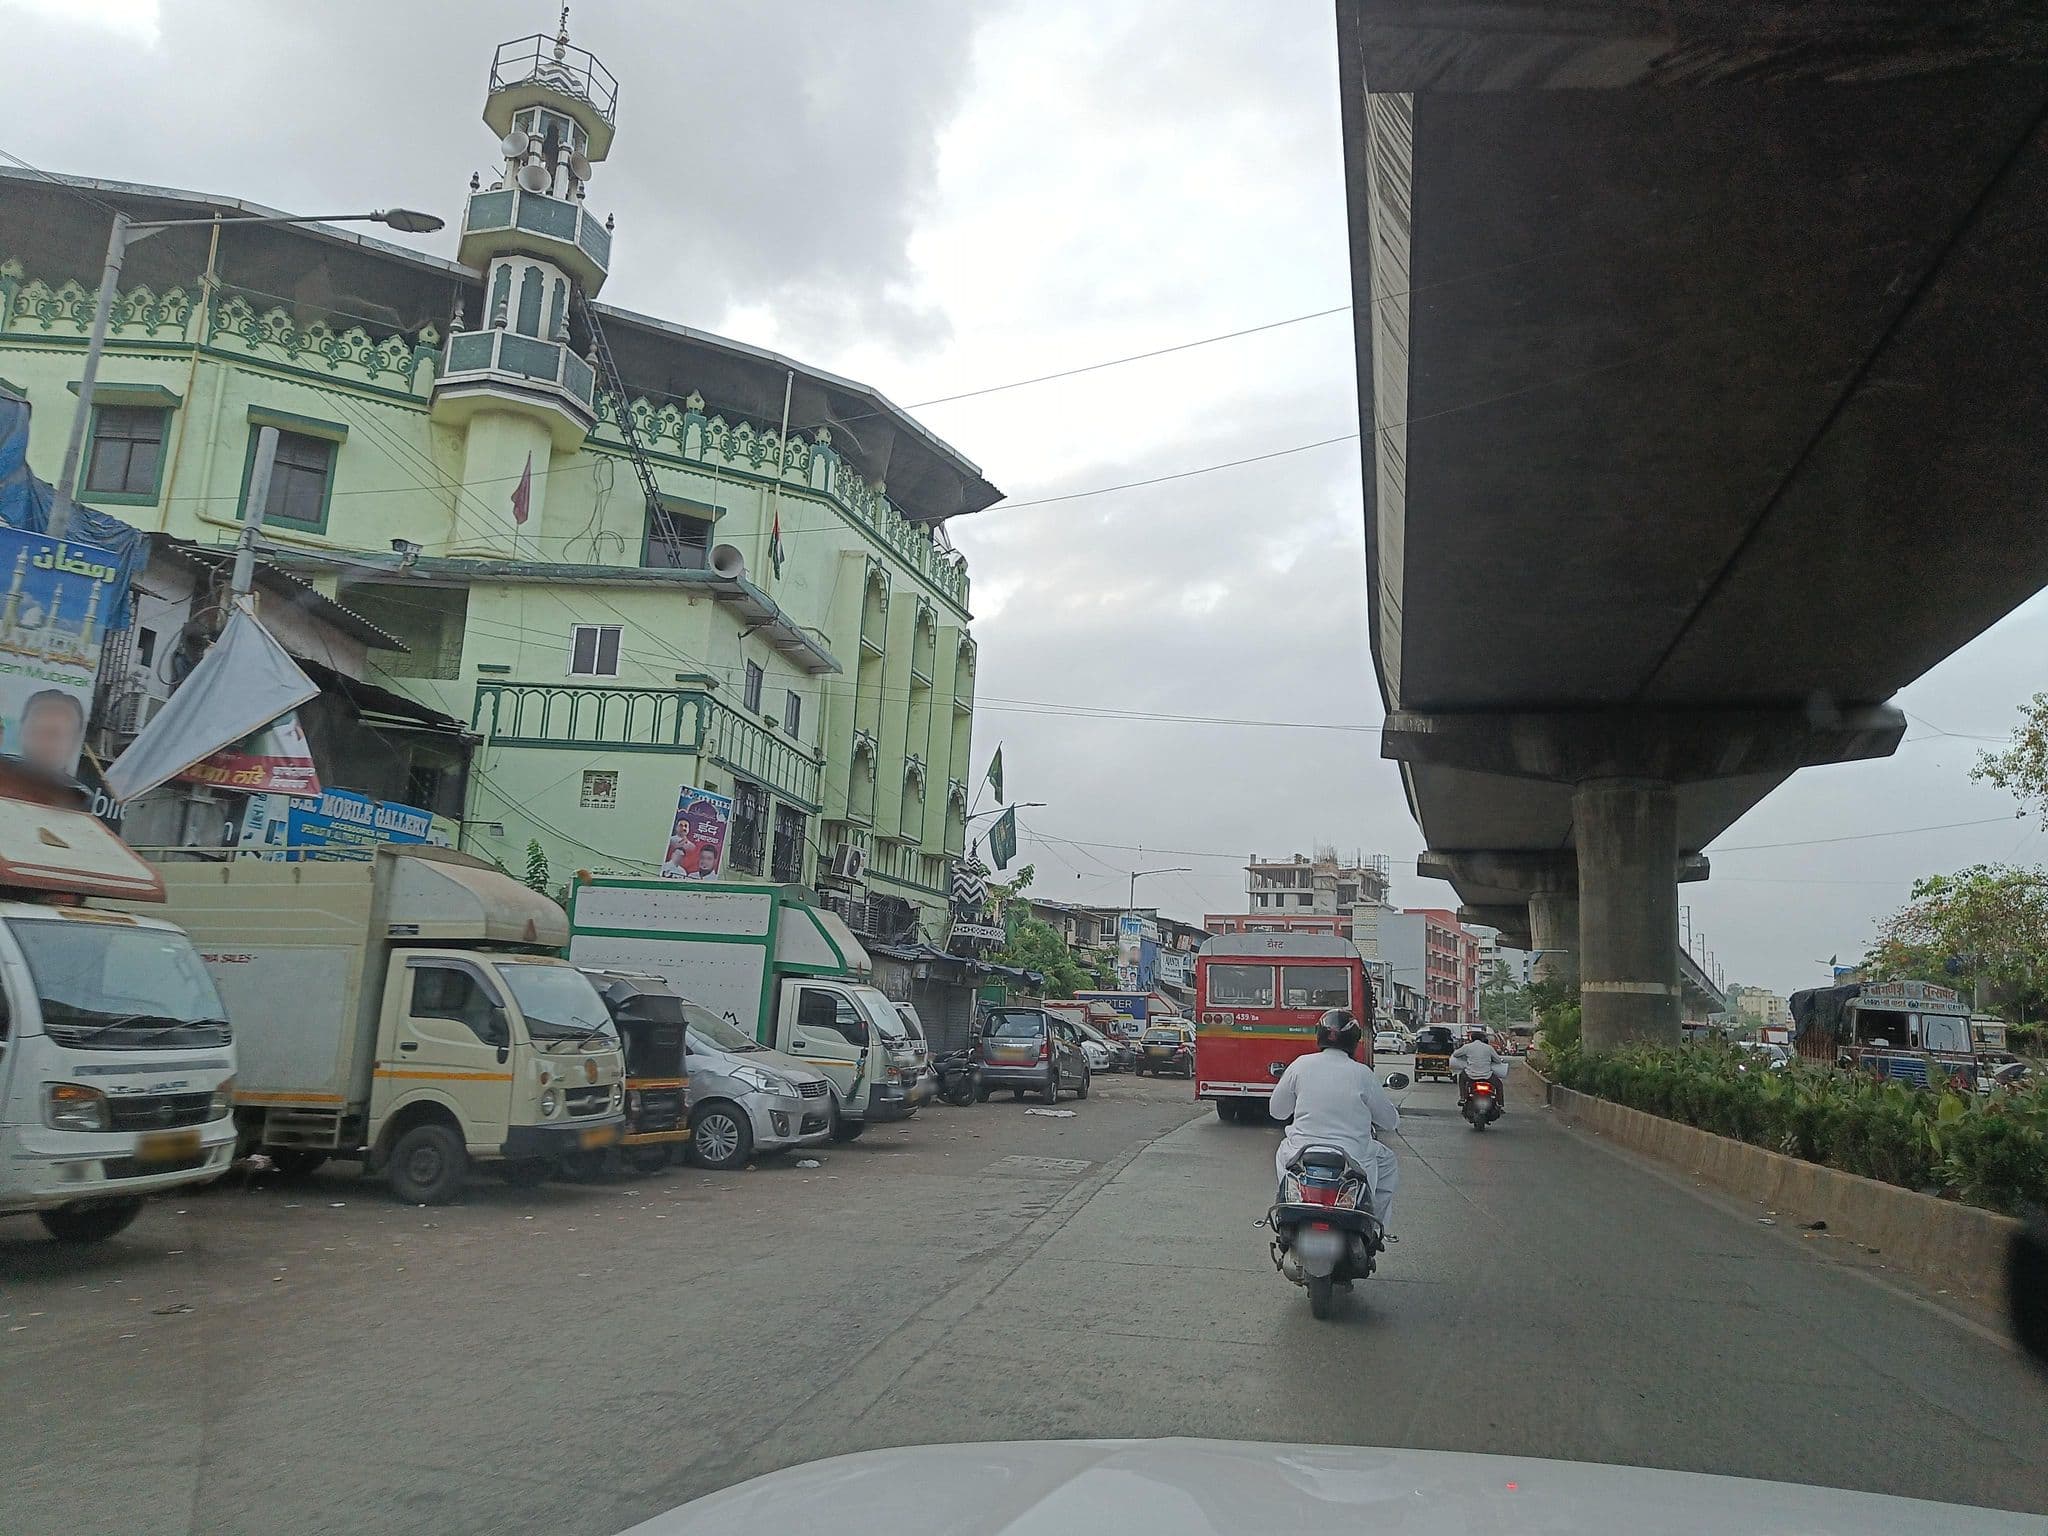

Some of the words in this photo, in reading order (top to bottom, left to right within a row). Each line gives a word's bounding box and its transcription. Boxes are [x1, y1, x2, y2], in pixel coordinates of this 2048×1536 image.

[32, 542, 117, 583] رمضان
[319, 794, 374, 826] MOBILE
[374, 804, 432, 838] GALLERY
[697, 821, 719, 836] ईद
